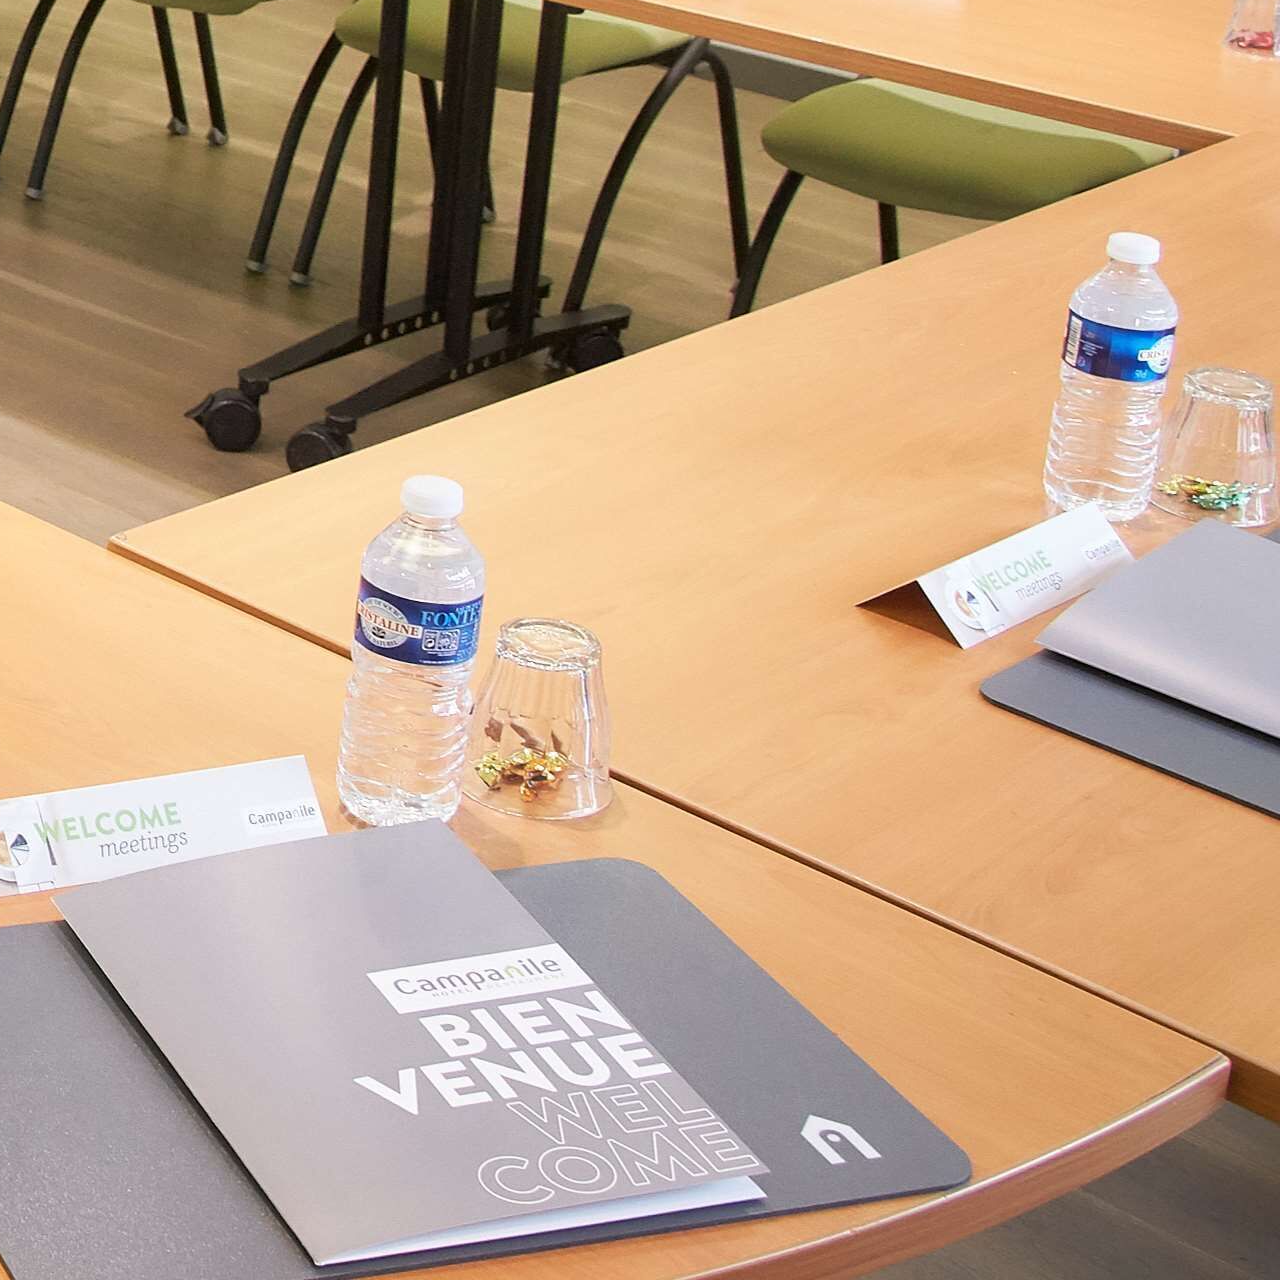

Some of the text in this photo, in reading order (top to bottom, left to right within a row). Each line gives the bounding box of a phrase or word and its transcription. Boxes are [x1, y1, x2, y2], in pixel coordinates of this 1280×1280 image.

[973, 551, 1053, 594] WELCOME
[1015, 571, 1065, 601] meetings
[32, 802, 182, 844] WELCOME
[248, 804, 316, 825] Campanile
[99, 830, 190, 859] meetings
[393, 957, 562, 996] Campanile
[419, 990, 633, 1059] BIEN
[352, 1033, 672, 1117] VENUE
[505, 1079, 716, 1146] WEL
[476, 1121, 761, 1205] COME
